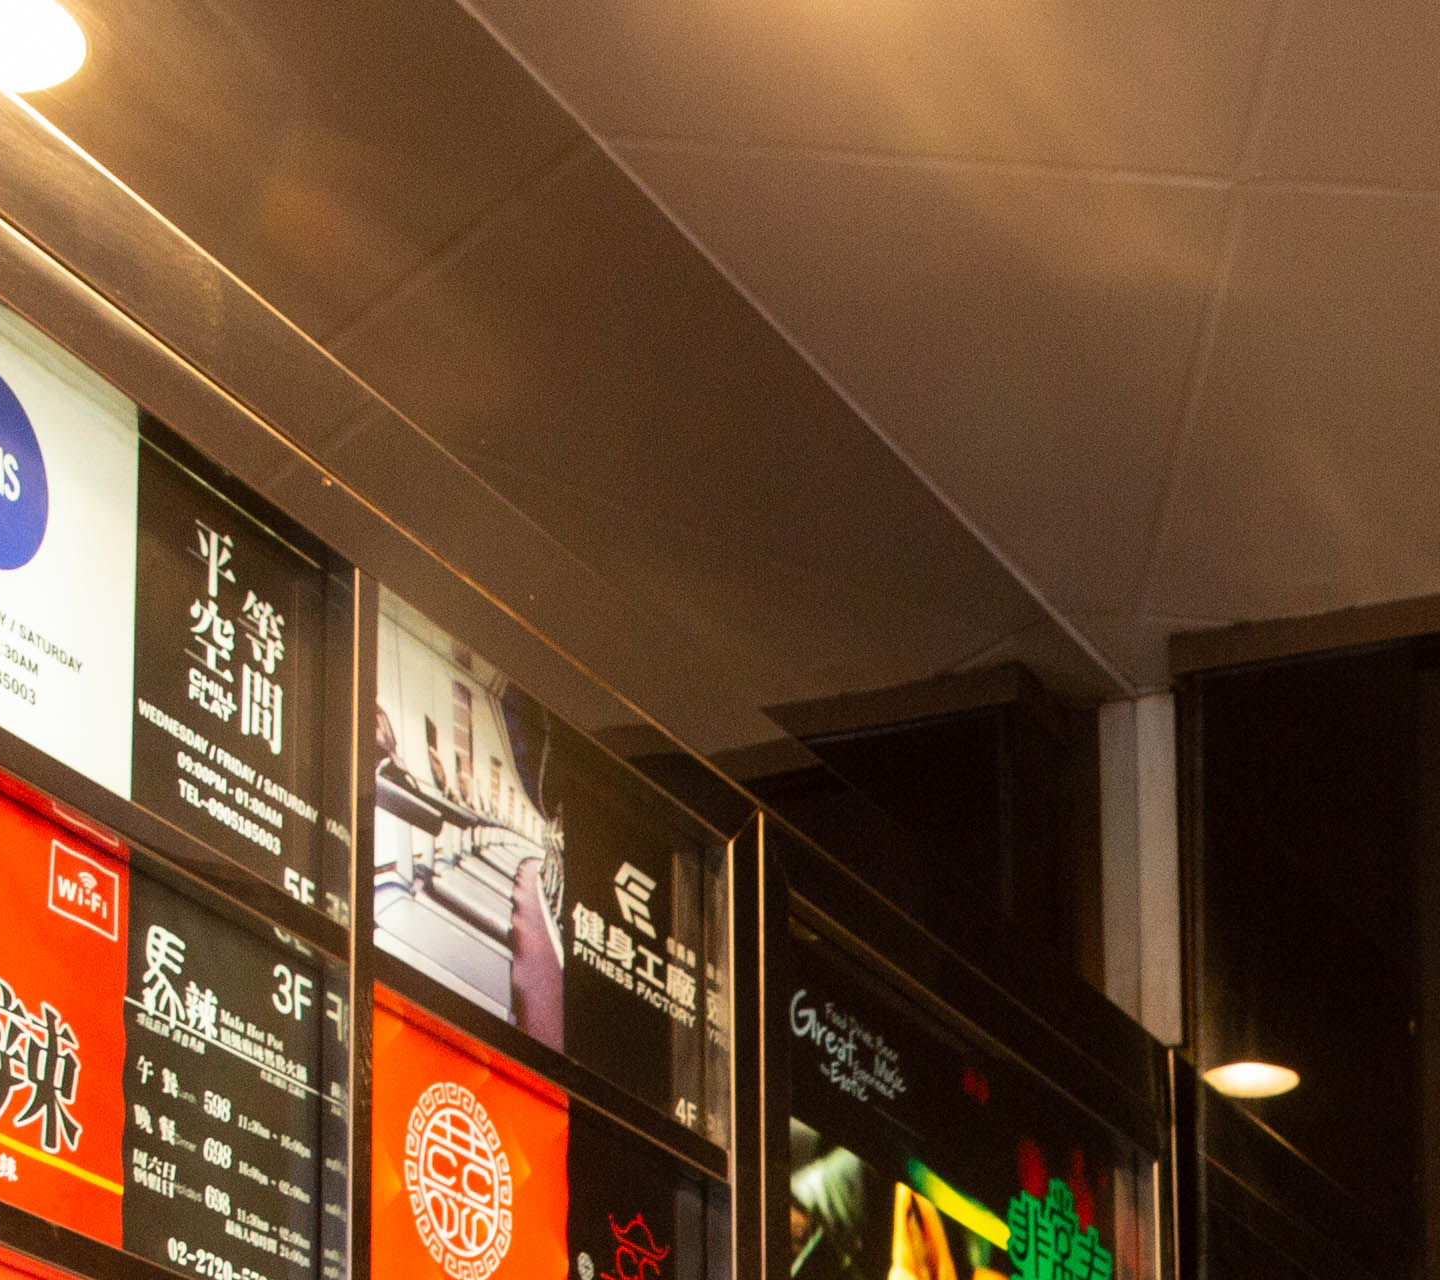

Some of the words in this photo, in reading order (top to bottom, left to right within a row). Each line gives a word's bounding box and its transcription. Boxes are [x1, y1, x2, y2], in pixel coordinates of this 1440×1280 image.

[19, 625, 83, 674] SATURDAY
[189, 668, 237, 710] CHILL
[189, 690, 234, 723] FLAT
[138, 698, 210, 752] WEDNESDAY
[217, 749, 255, 785] FRIDAY
[263, 777, 318, 823] SATURDAY
[178, 752, 226, 791] 09:00PM
[236, 790, 283, 829] 01:00AM
[57, 873, 107, 920] Wi-Fi
[283, 868, 316, 905] 5F
[573, 902, 697, 1011] 健身工廠
[272, 964, 313, 1021] 3F
[573, 946, 634, 991] FITNESS
[637, 981, 697, 1029] FACTORY
[203, 1090, 232, 1123] 598
[675, 1098, 697, 1129] 4F
[203, 1137, 232, 1169] 698
[205, 1185, 231, 1216] 698
